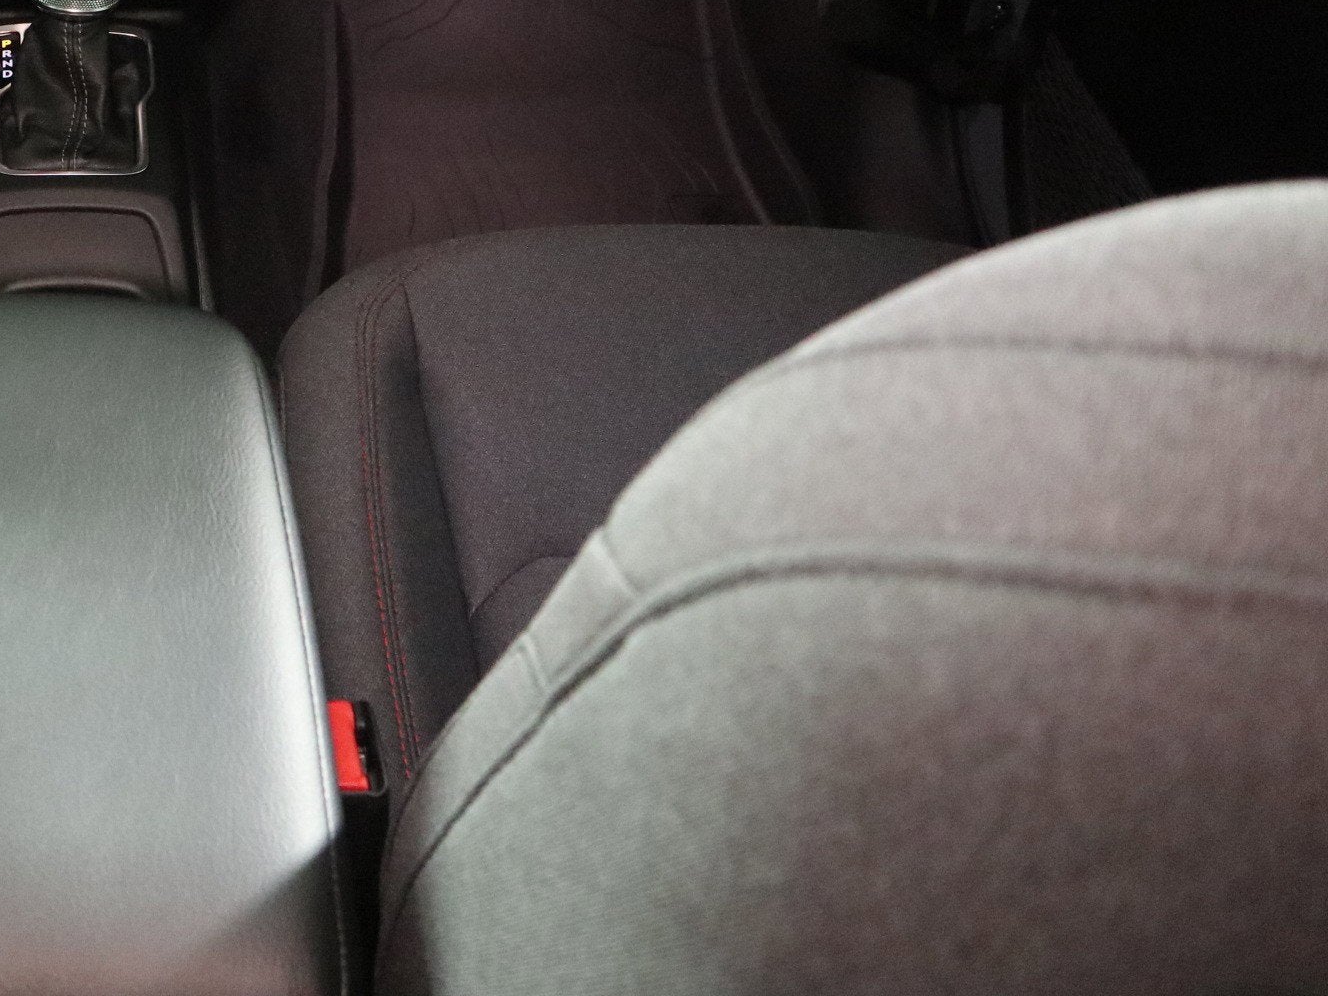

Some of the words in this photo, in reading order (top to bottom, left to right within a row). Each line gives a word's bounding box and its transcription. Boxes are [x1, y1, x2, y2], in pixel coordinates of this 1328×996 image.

[2, 39, 12, 49] P
[2, 50, 12, 58] R
[2, 60, 14, 68] N
[2, 70, 14, 78] D
